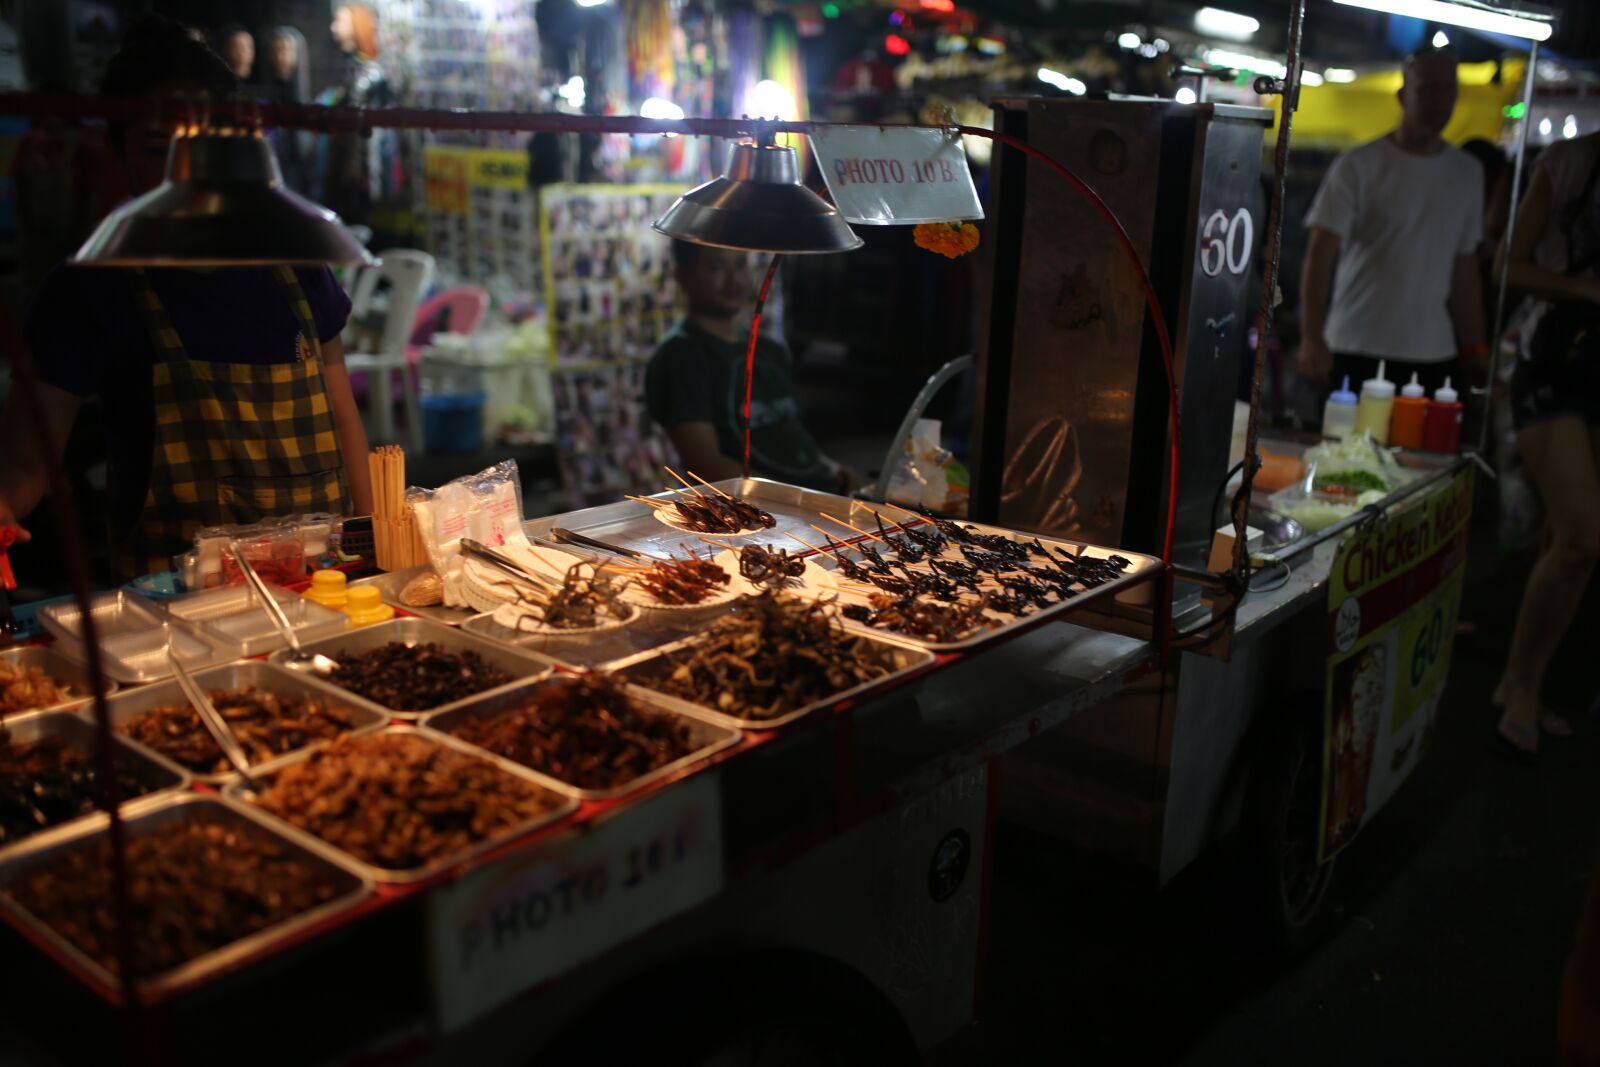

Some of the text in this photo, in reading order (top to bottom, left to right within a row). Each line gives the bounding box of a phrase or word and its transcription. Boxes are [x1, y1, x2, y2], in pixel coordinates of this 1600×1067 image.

[833, 157, 905, 185] PHOTO
[912, 157, 936, 184] 10
[1200, 207, 1254, 278] 60
[1344, 519, 1429, 591] Chicken
[1411, 608, 1443, 688] 60
[460, 864, 610, 971] PHOTO
